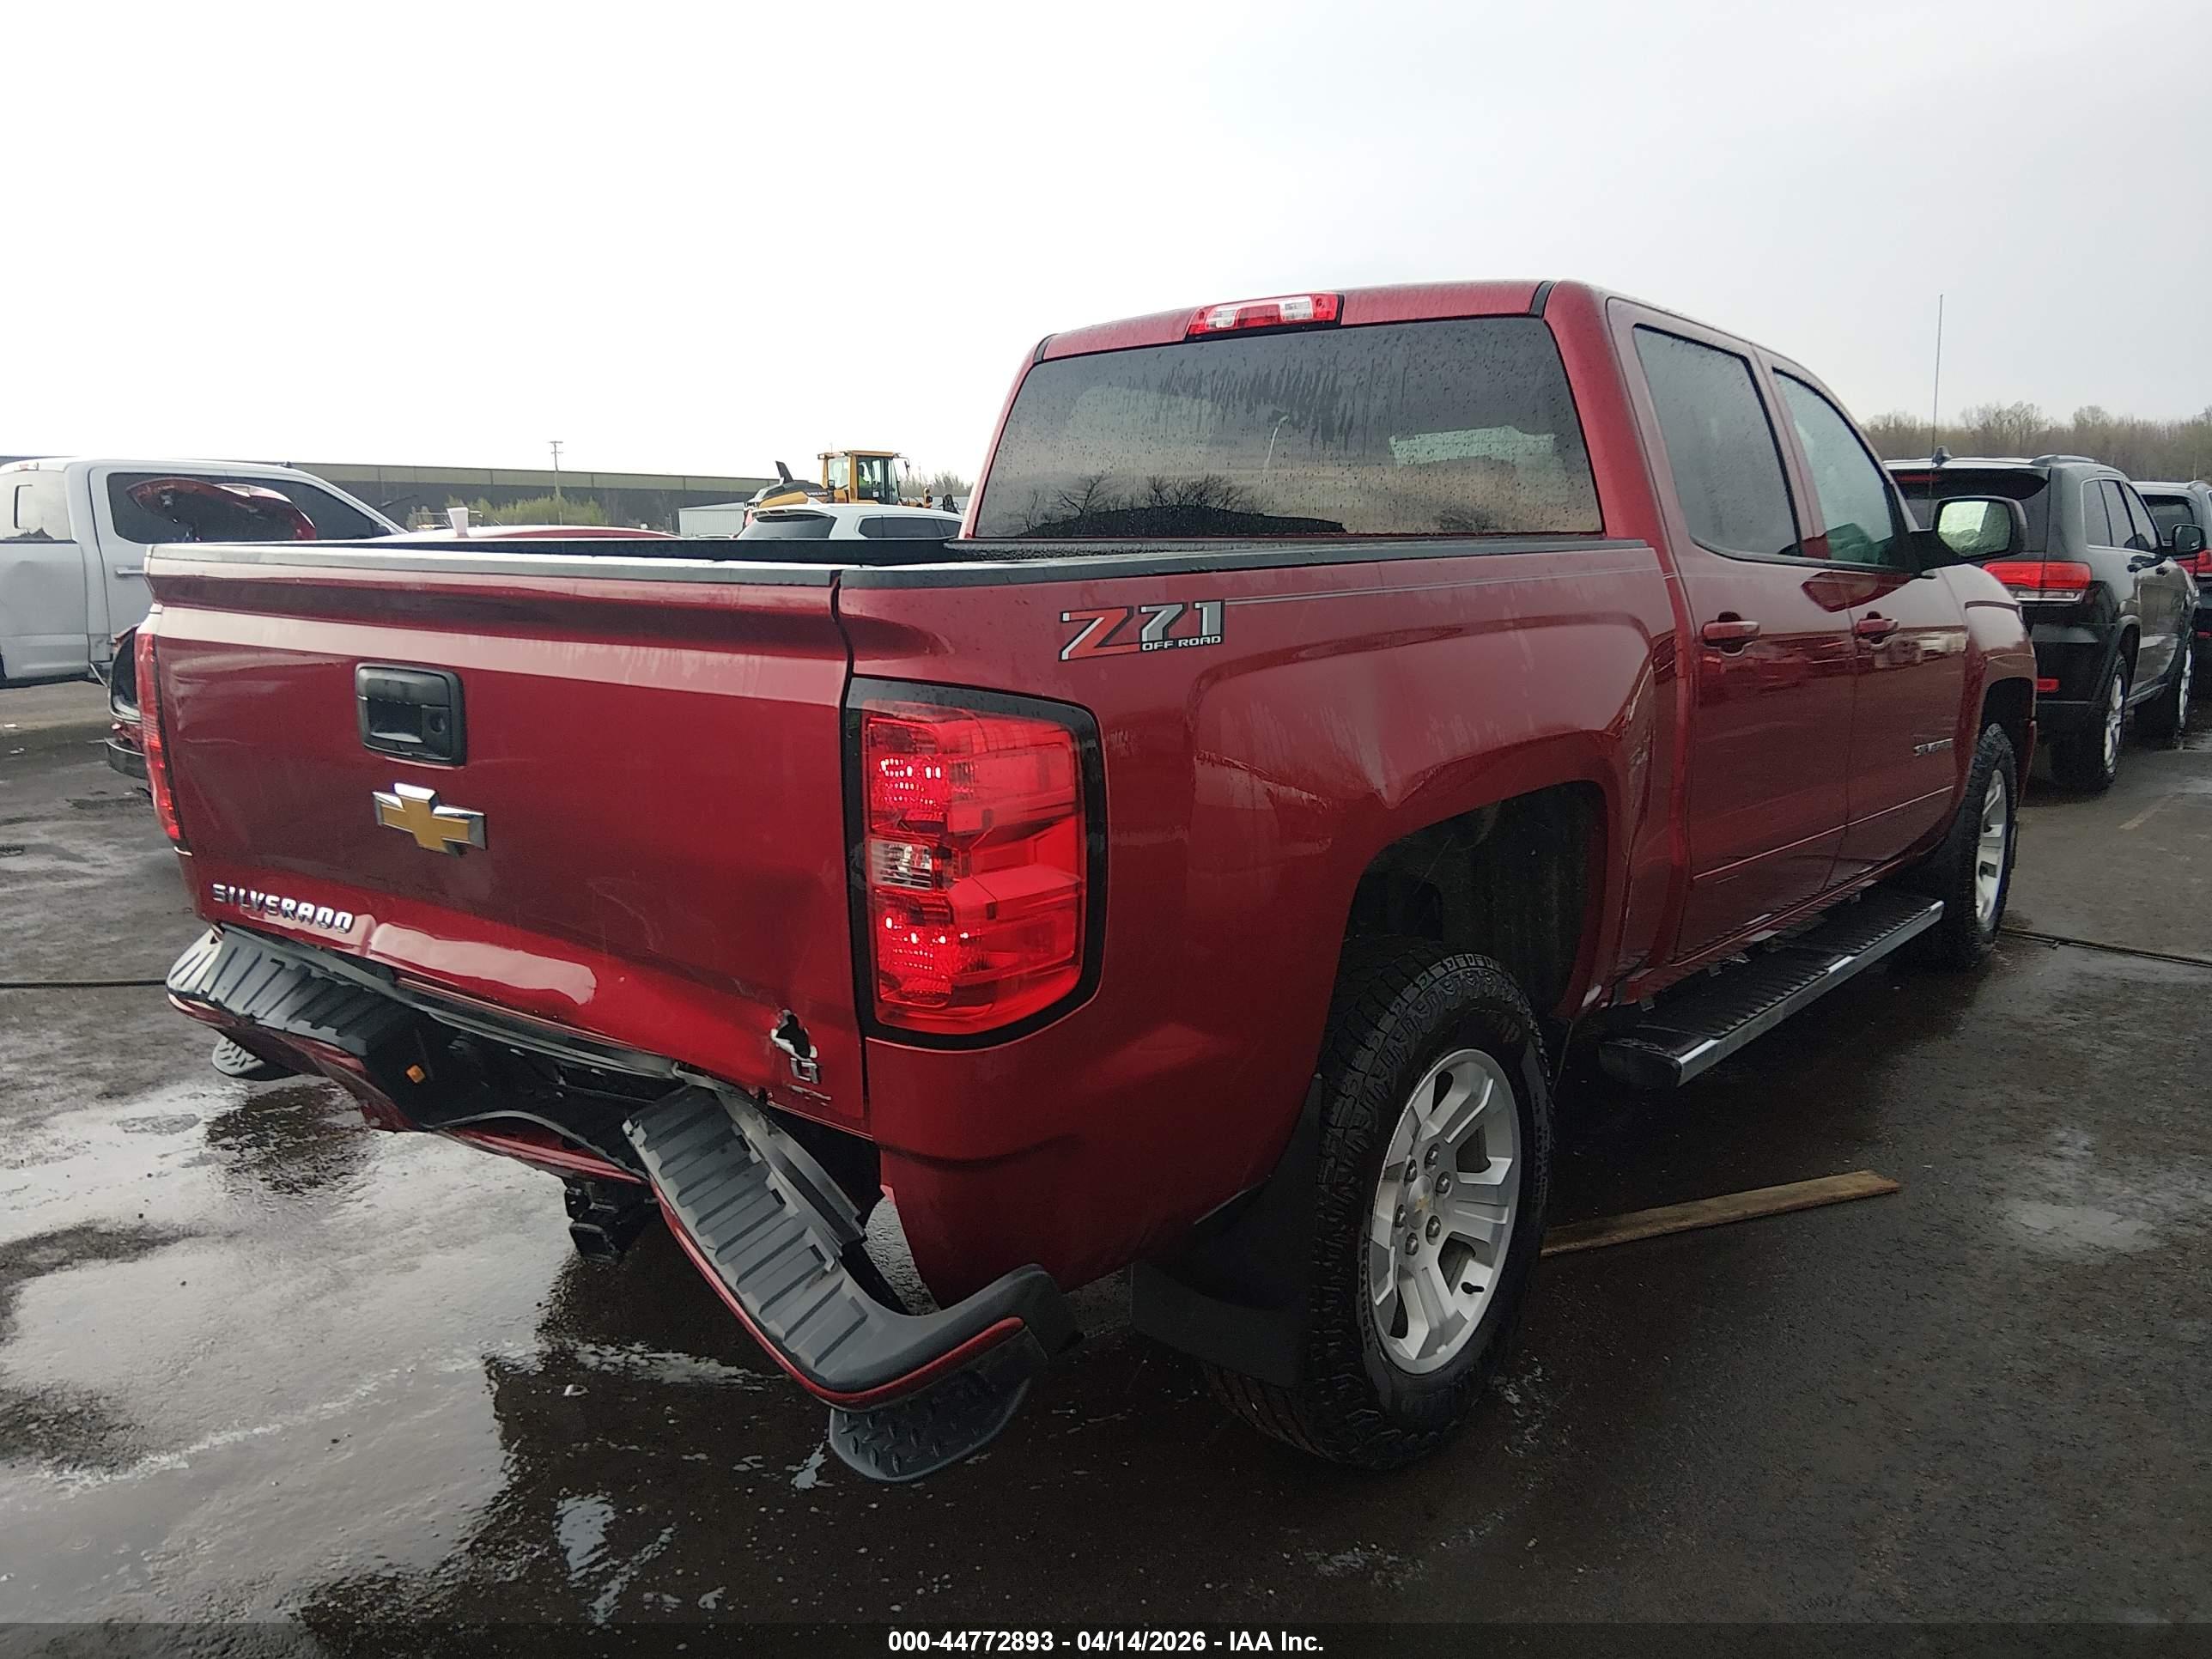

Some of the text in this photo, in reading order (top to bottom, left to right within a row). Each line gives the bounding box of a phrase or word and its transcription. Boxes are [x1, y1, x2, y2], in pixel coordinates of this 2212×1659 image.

[1060, 600, 1224, 660] Z71
[1141, 635, 1222, 652] OFF ROAD
[212, 884, 355, 934] SILVERADO
